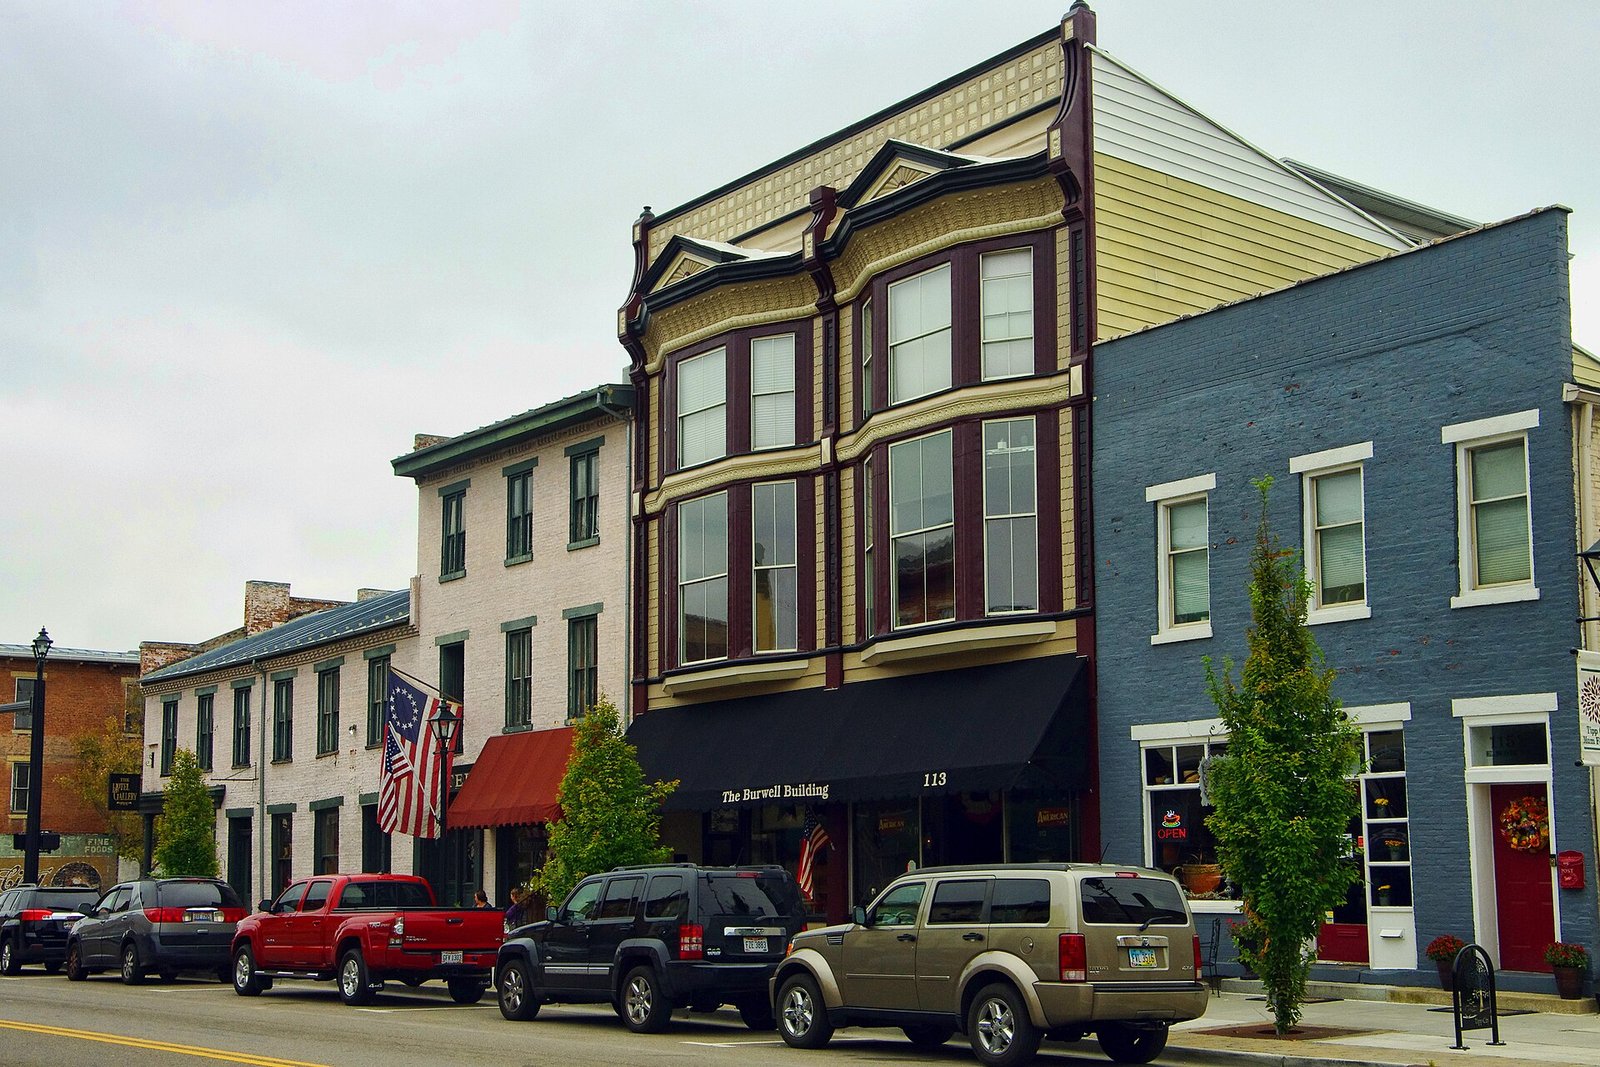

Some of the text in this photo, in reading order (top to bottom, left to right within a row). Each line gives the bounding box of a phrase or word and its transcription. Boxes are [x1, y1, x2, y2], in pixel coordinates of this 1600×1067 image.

[923, 772, 947, 787] 113
[722, 783, 829, 803] The Burwell Building
[1157, 828, 1186, 839] OPEN
[87, 838, 110, 846] FINE
[84, 845, 113, 853] FOODS
